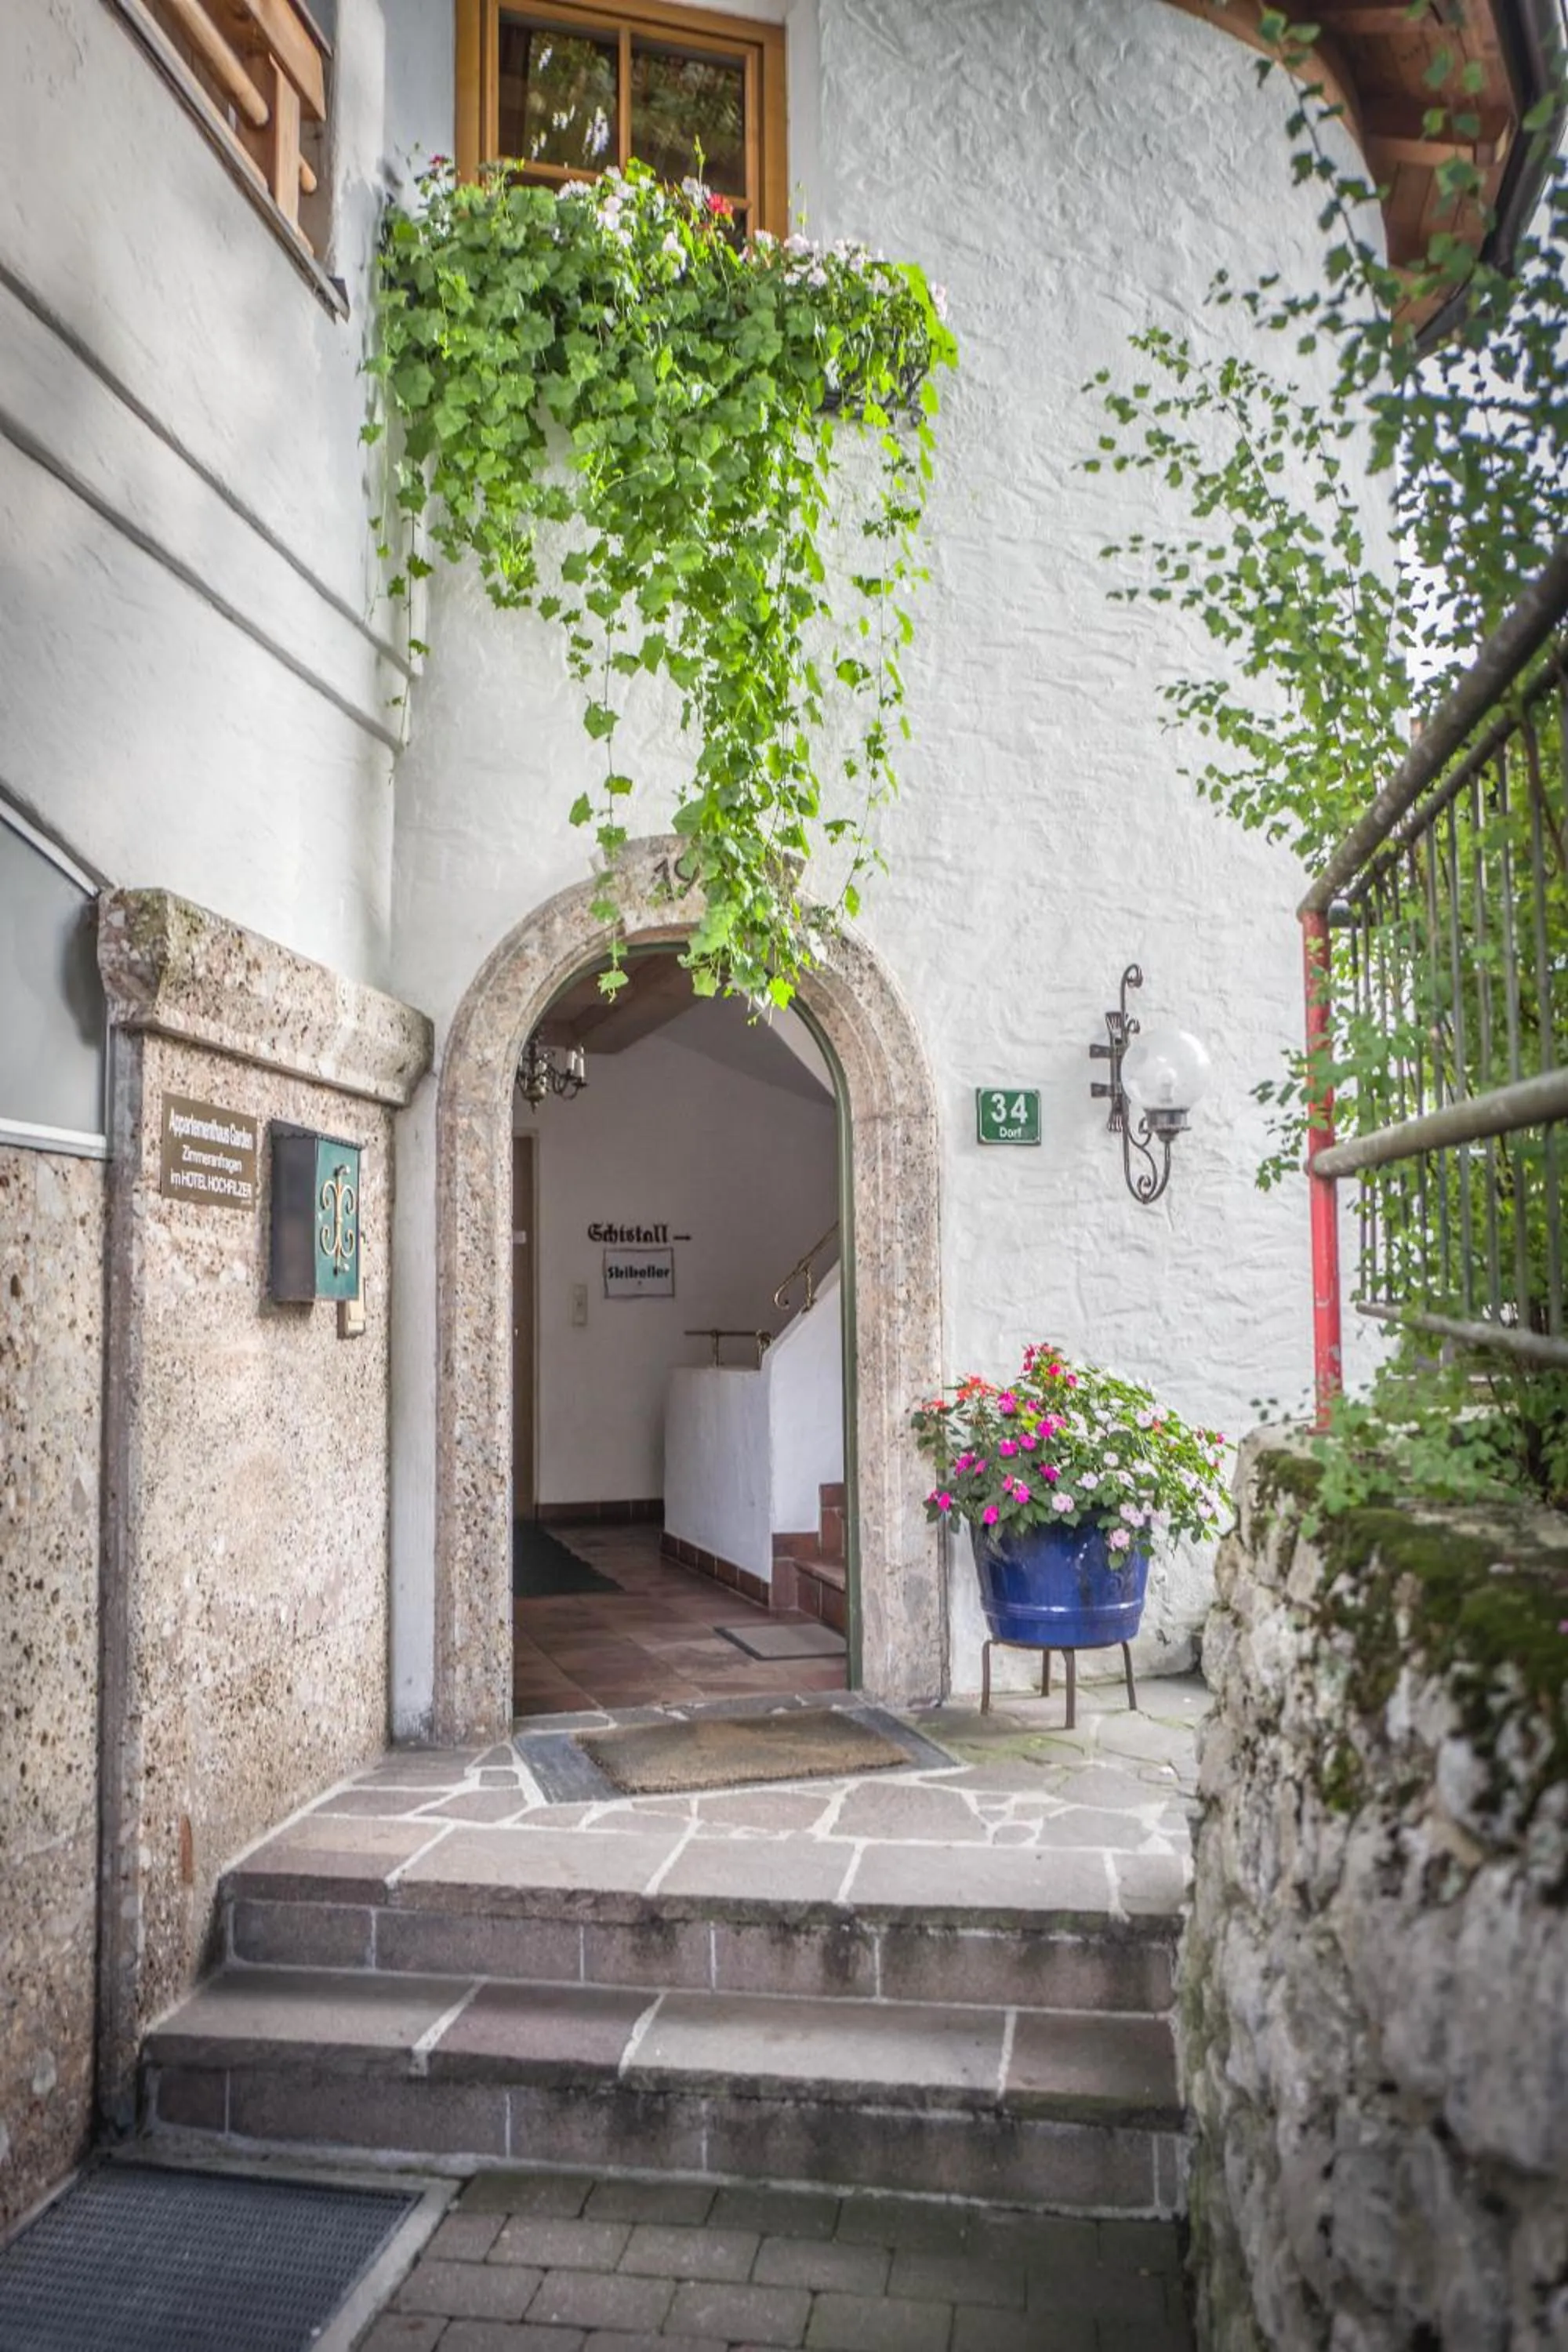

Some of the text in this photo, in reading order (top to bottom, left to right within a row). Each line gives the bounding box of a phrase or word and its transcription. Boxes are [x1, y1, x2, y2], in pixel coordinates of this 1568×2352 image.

[991, 1093, 1028, 1123] 34
[999, 1126, 1022, 1138] Dorf
[181, 1169, 208, 1191] HOTEL
[208, 1175, 252, 1199] HOCHFILZER
[588, 1223, 668, 1244] Schistall
